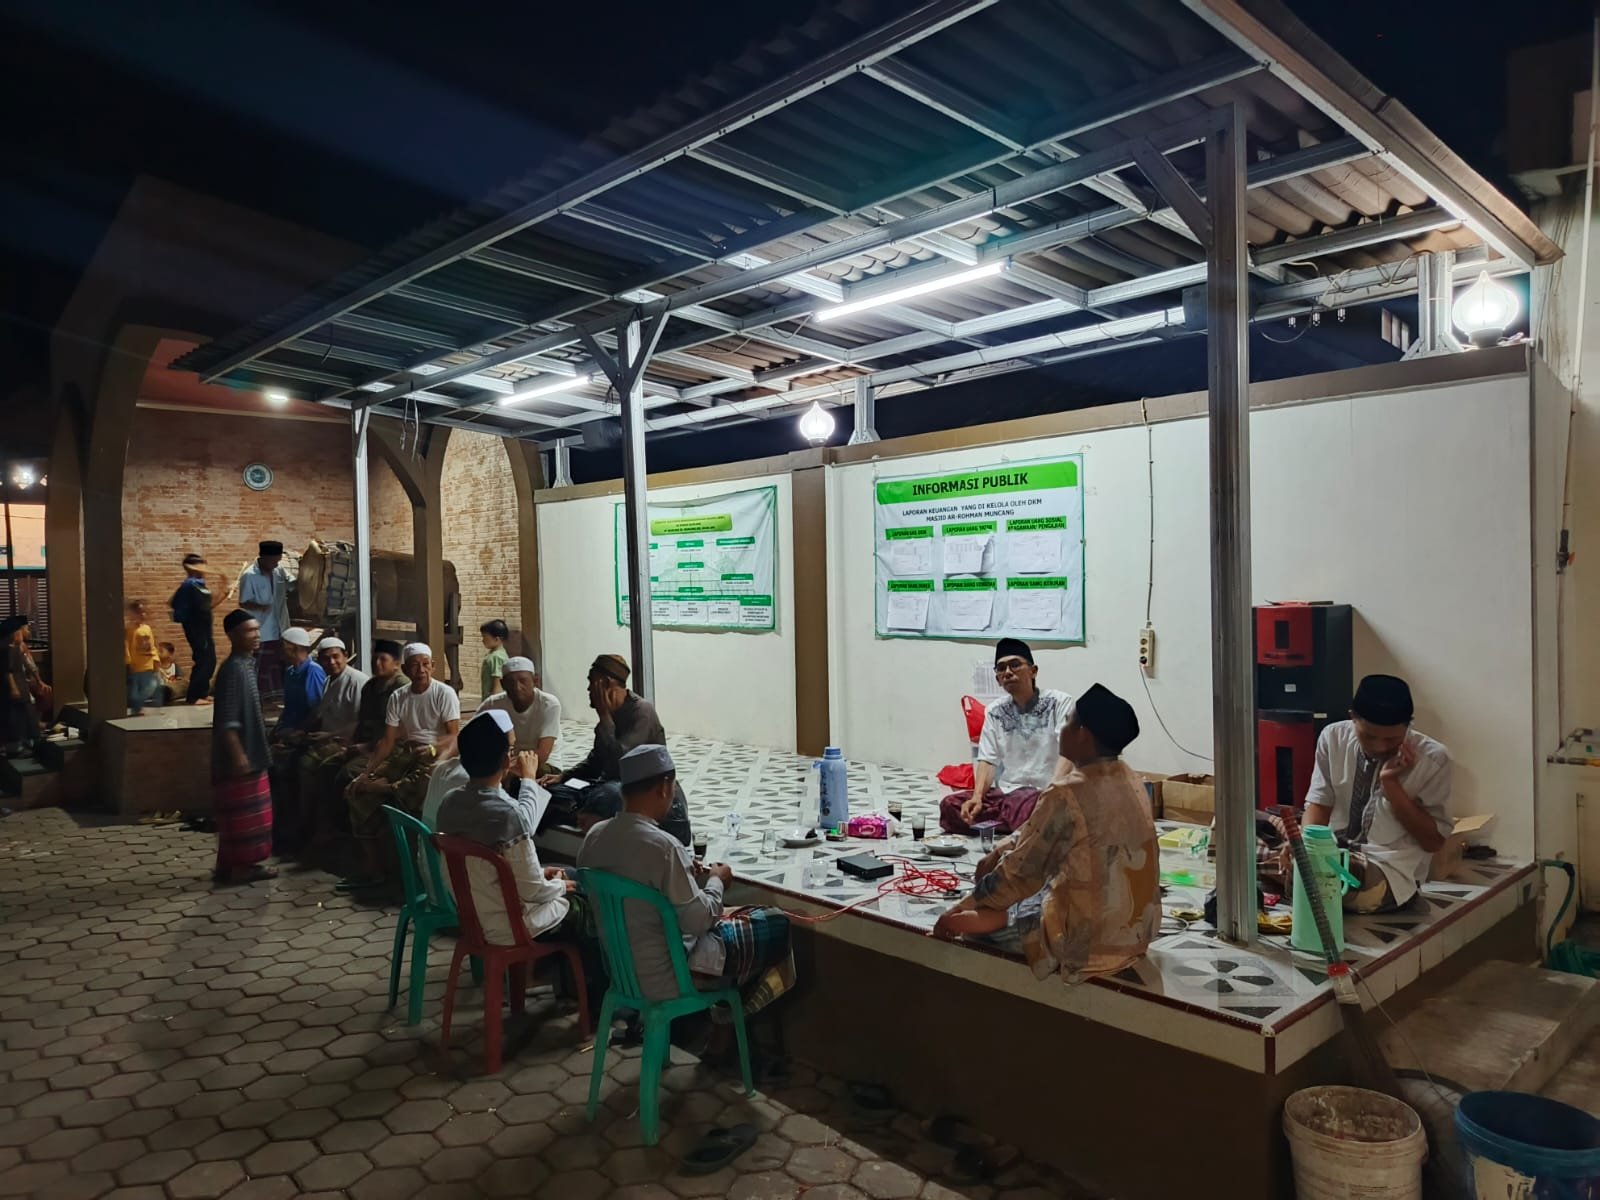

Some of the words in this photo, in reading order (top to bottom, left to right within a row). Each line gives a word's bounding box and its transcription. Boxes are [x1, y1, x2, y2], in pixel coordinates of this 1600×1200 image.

[912, 478, 979, 496] INFORMASI
[982, 472, 1028, 489] PUBLIK
[902, 508, 927, 517] LAPORAN
[928, 506, 958, 515] KEUANGAN
[961, 504, 976, 512] YANG
[977, 503, 985, 511] DI
[986, 501, 1009, 510] KELOLA
[1010, 499, 1026, 508] OLEH
[1027, 498, 1042, 507] DKM
[926, 514, 946, 522] MASJID
[947, 511, 983, 521] AR-ROHMAN
[984, 509, 1015, 518] MUNCANG
